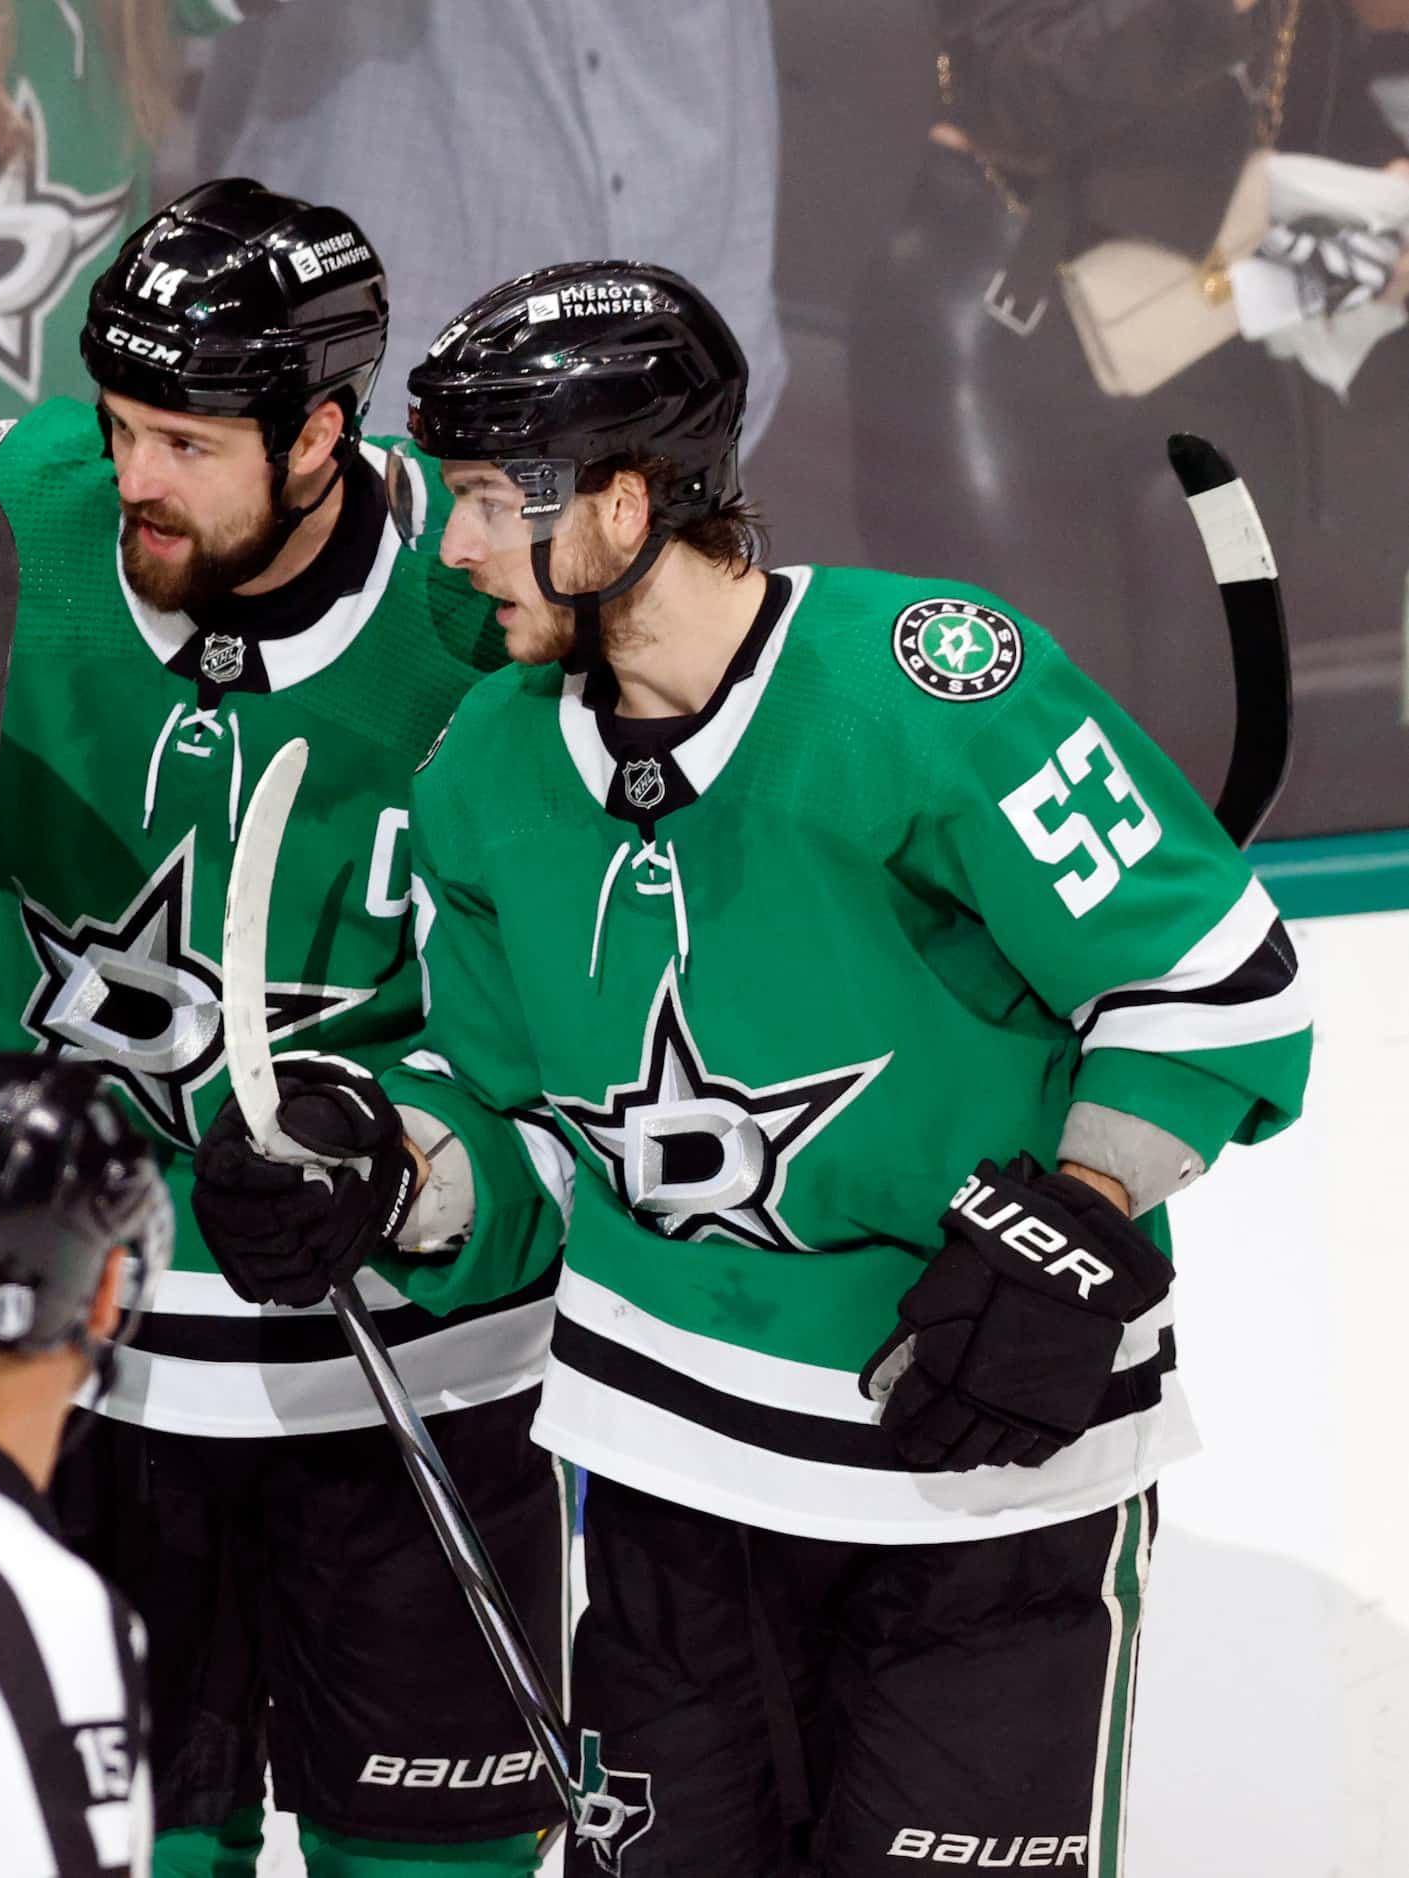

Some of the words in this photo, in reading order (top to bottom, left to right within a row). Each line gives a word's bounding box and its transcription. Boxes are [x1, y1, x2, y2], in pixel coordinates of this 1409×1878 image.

[313, 232, 355, 258] ENERGY
[320, 245, 371, 274] TRANSFER
[138, 262, 189, 306] 14
[561, 286, 633, 304] ENERGY
[563, 299, 654, 319] TRANSFER
[106, 326, 183, 365] CCM
[902, 604, 978, 672] DALLAS
[948, 629, 1013, 693] STARS
[998, 716, 1163, 920] 53
[73, 1727, 129, 1799] 15
